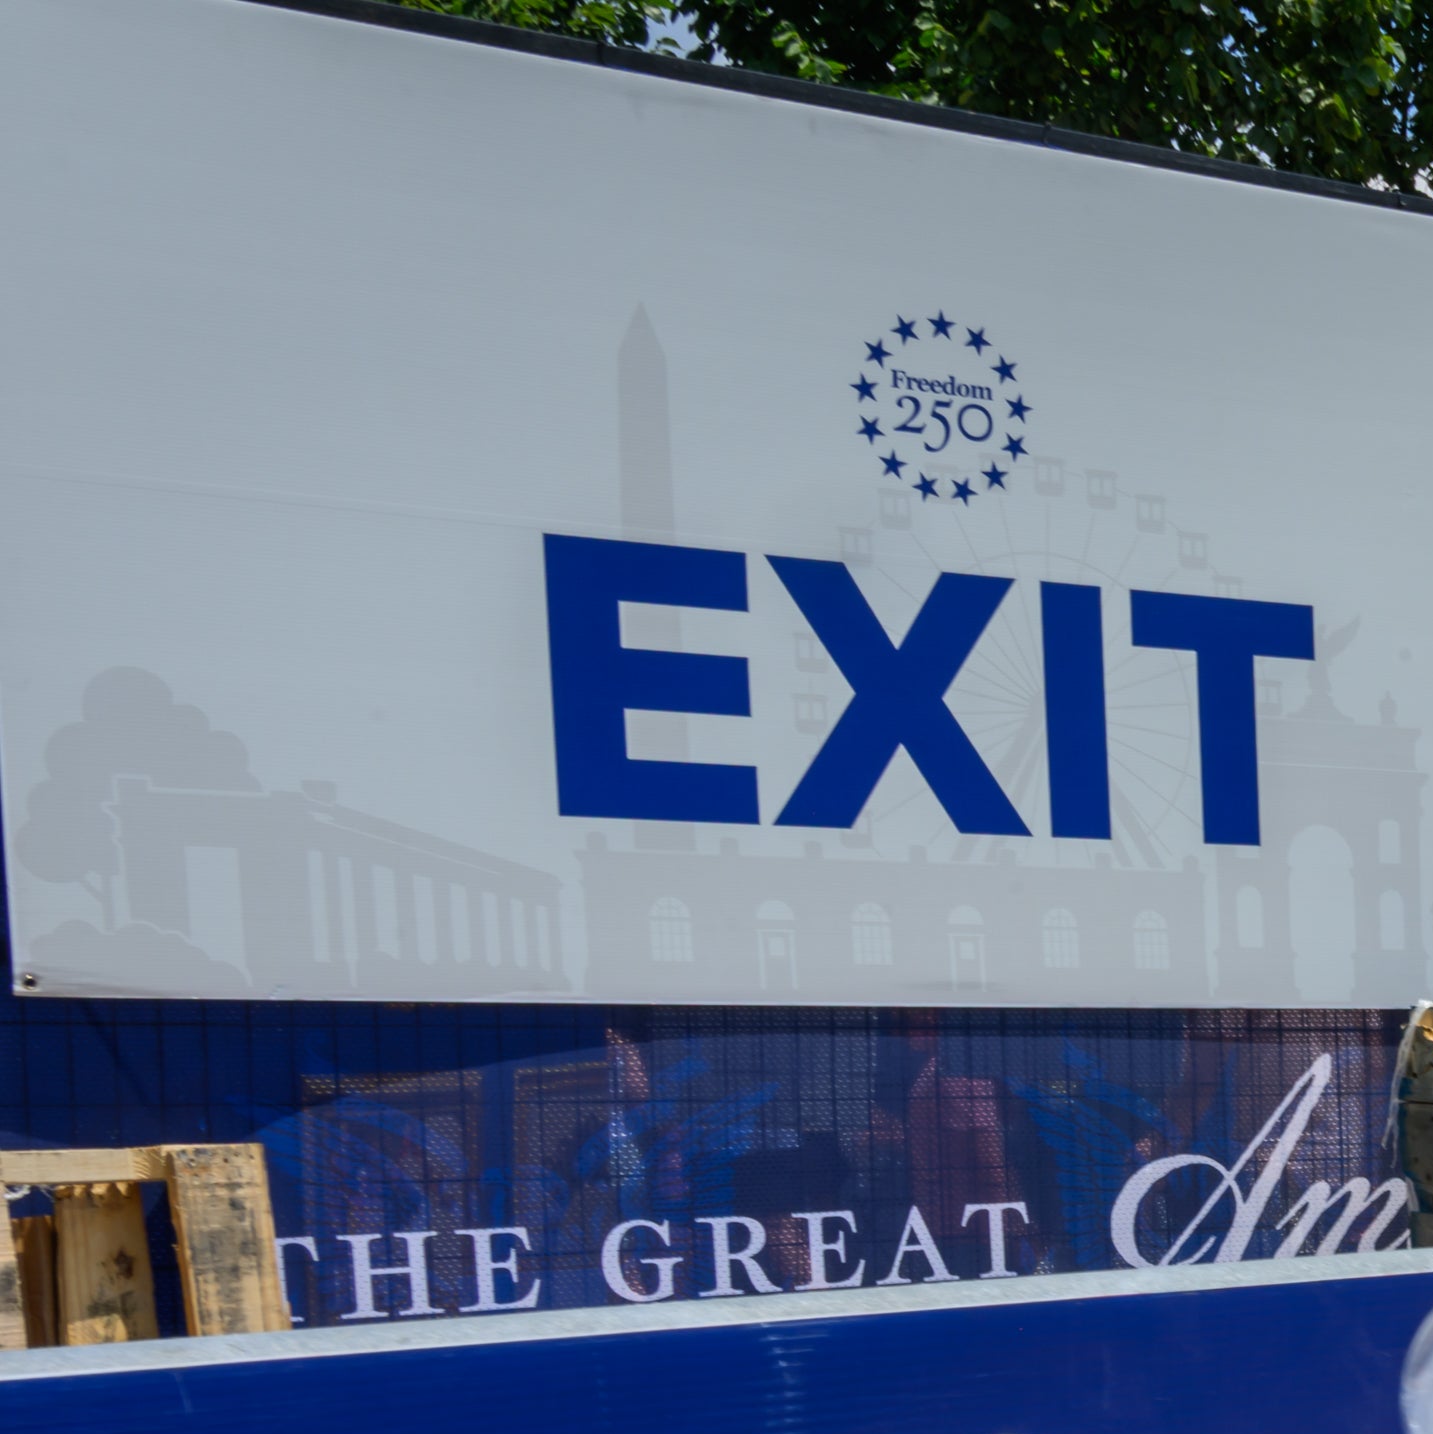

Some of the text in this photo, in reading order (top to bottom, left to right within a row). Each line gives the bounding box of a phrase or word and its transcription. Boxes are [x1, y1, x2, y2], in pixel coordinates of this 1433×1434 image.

[891, 368, 993, 401] Freedom
[893, 395, 993, 453] 250
[542, 532, 1316, 846] EXIT
[602, 1201, 1029, 1302] GREAT
